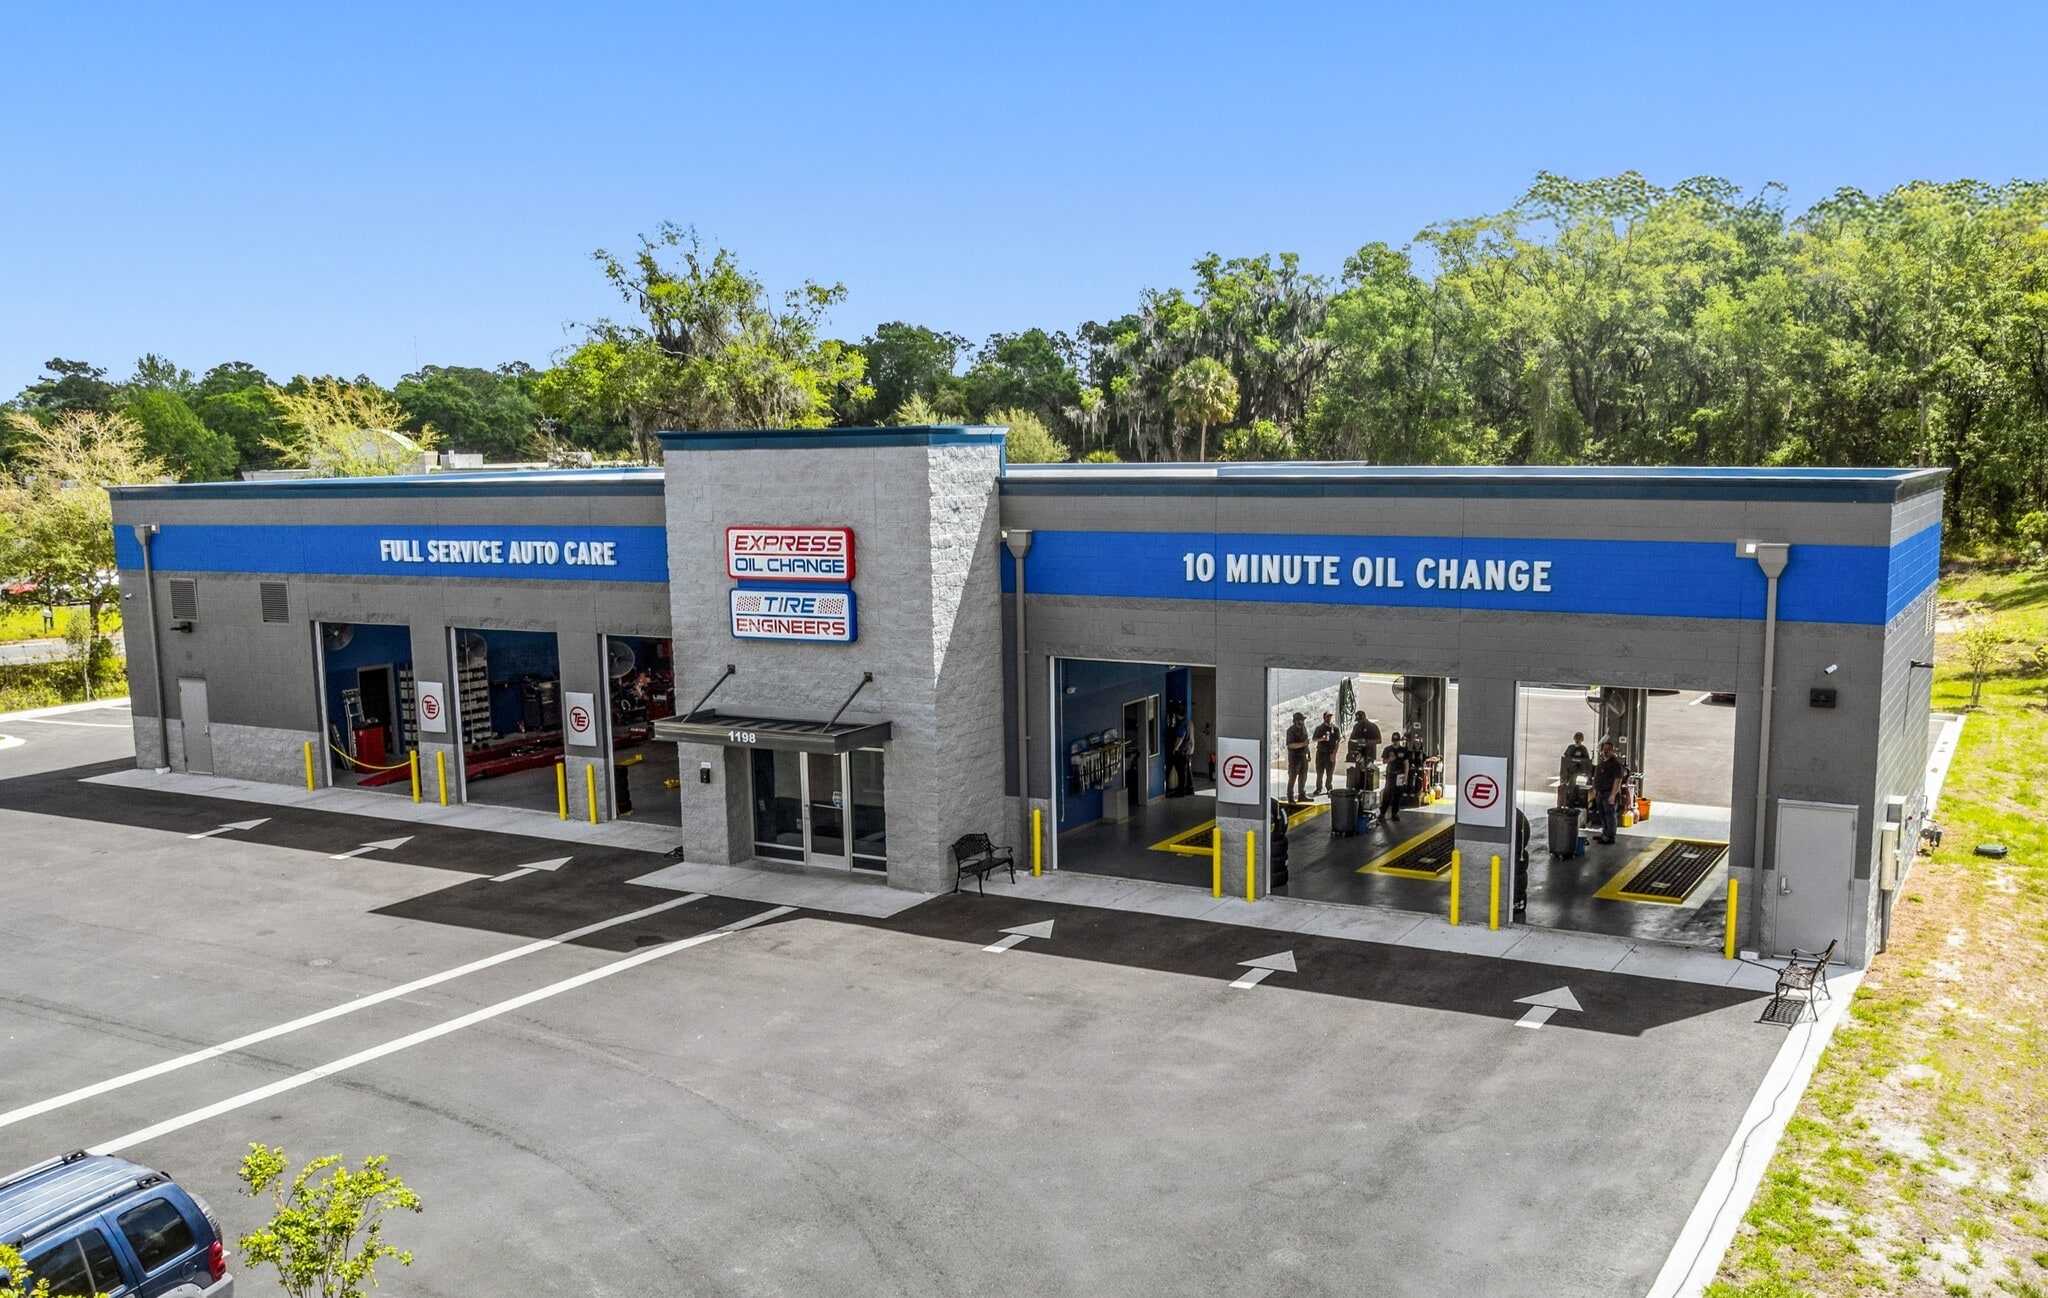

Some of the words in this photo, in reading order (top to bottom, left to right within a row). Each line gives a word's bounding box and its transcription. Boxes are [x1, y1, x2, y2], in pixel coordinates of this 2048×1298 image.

[380, 539, 424, 562] FULL
[427, 540, 504, 563] SERVICE
[508, 540, 559, 565] AUTO
[563, 541, 617, 566] CARE
[735, 535, 843, 552] EXPRESS
[735, 557, 763, 572] OIL
[767, 558, 845, 573] CHANGE
[1183, 552, 1215, 582] 10
[1226, 553, 1341, 586] MINUTE
[1352, 556, 1404, 588] OIL
[1415, 557, 1551, 592] CHANGE
[764, 596, 816, 614] TIRE
[736, 618, 846, 636] ENGINEERS
[728, 730, 756, 744] 1198
